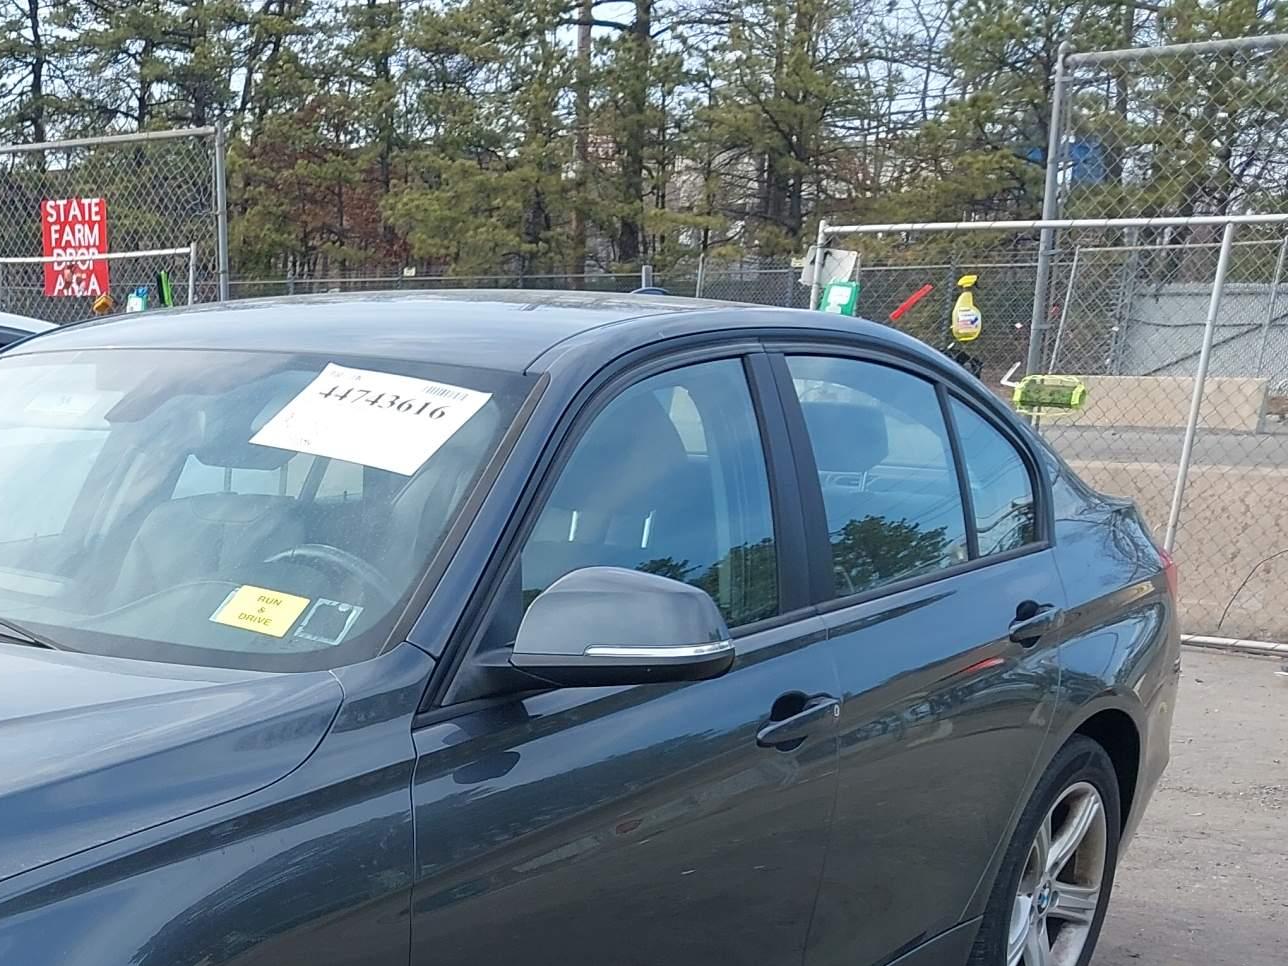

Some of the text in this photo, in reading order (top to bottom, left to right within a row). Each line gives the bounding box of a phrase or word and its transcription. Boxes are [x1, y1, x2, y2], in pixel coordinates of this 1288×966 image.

[46, 198, 101, 222] STATE
[50, 222, 99, 247] FARM
[53, 246, 99, 270] DROP
[318, 385, 452, 420] 44743616
[257, 595, 283, 606] RUN
[257, 606, 265, 614] &
[237, 612, 273, 626] DRIVE
